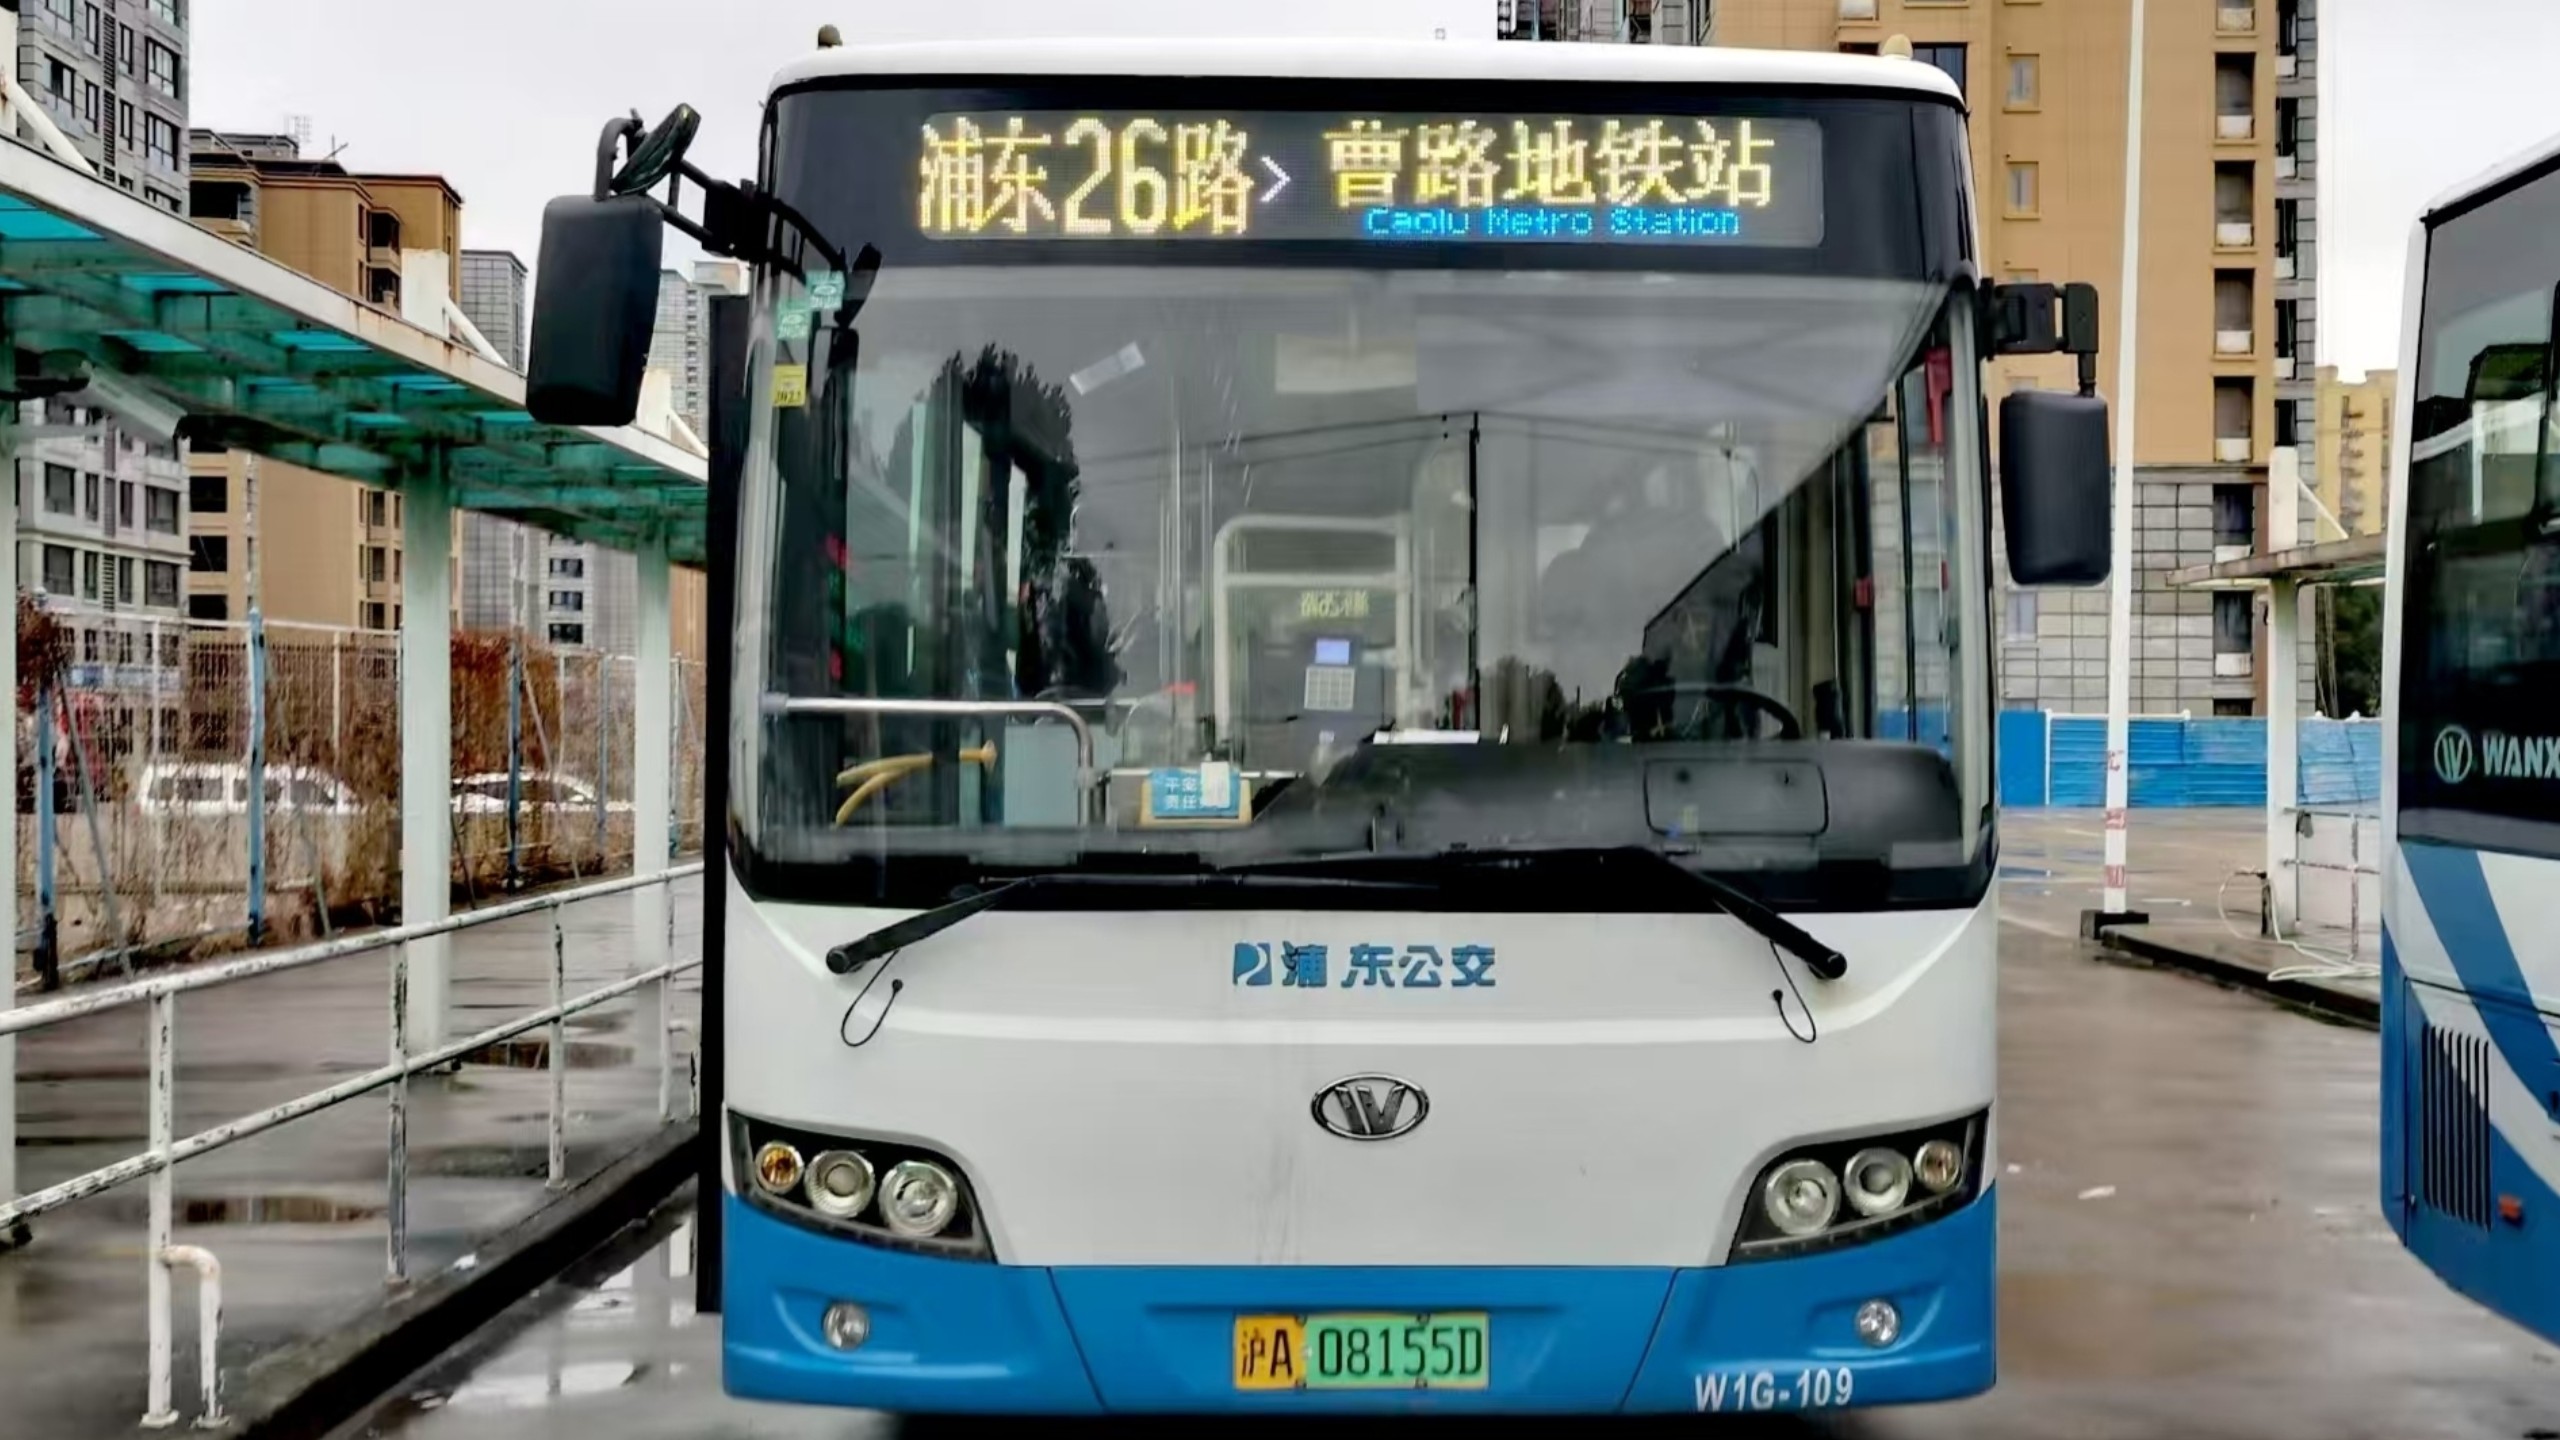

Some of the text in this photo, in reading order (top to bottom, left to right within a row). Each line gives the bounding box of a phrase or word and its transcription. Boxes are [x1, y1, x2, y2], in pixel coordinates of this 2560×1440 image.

[919, 117, 1254, 234] 浦东26路
[1322, 119, 1775, 207] 曹路地铁站
[1367, 208, 1740, 236] Caolu Metro Station
[2482, 733, 2560, 779] WANX
[1281, 941, 1496, 988] 浦东公交
[1694, 1366, 1854, 1413] W1G-109
